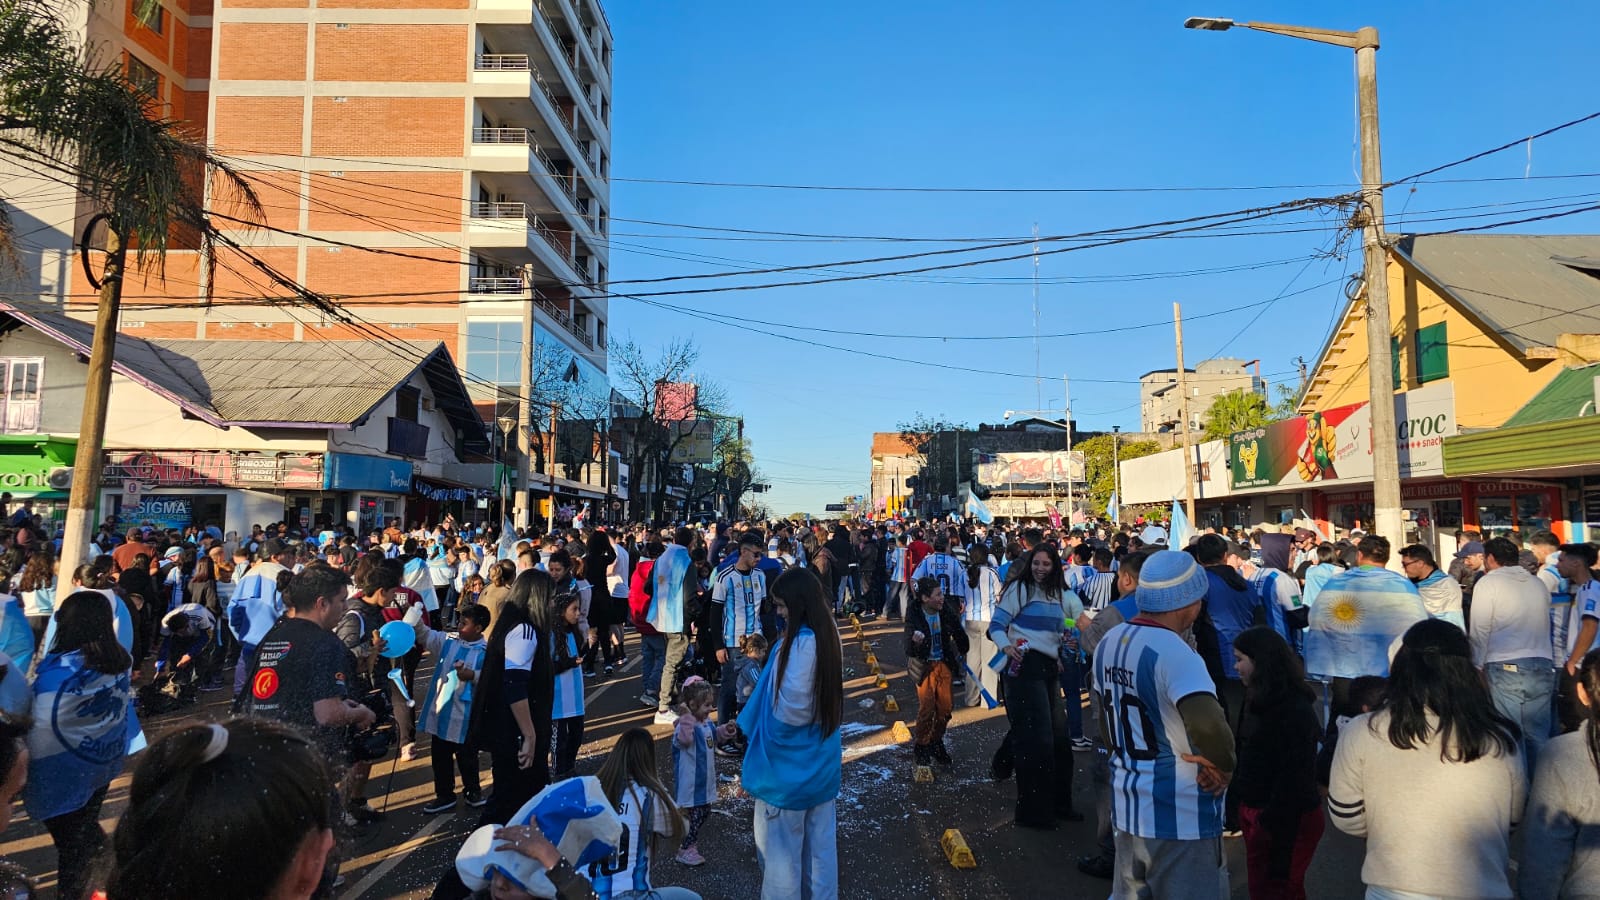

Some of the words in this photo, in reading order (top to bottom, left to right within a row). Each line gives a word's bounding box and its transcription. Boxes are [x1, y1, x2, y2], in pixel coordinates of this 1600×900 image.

[137, 501, 186, 514] SIGMA
[1104, 665, 1135, 689] MESSI
[1103, 689, 1160, 761] 10
[617, 802, 629, 816] SI
